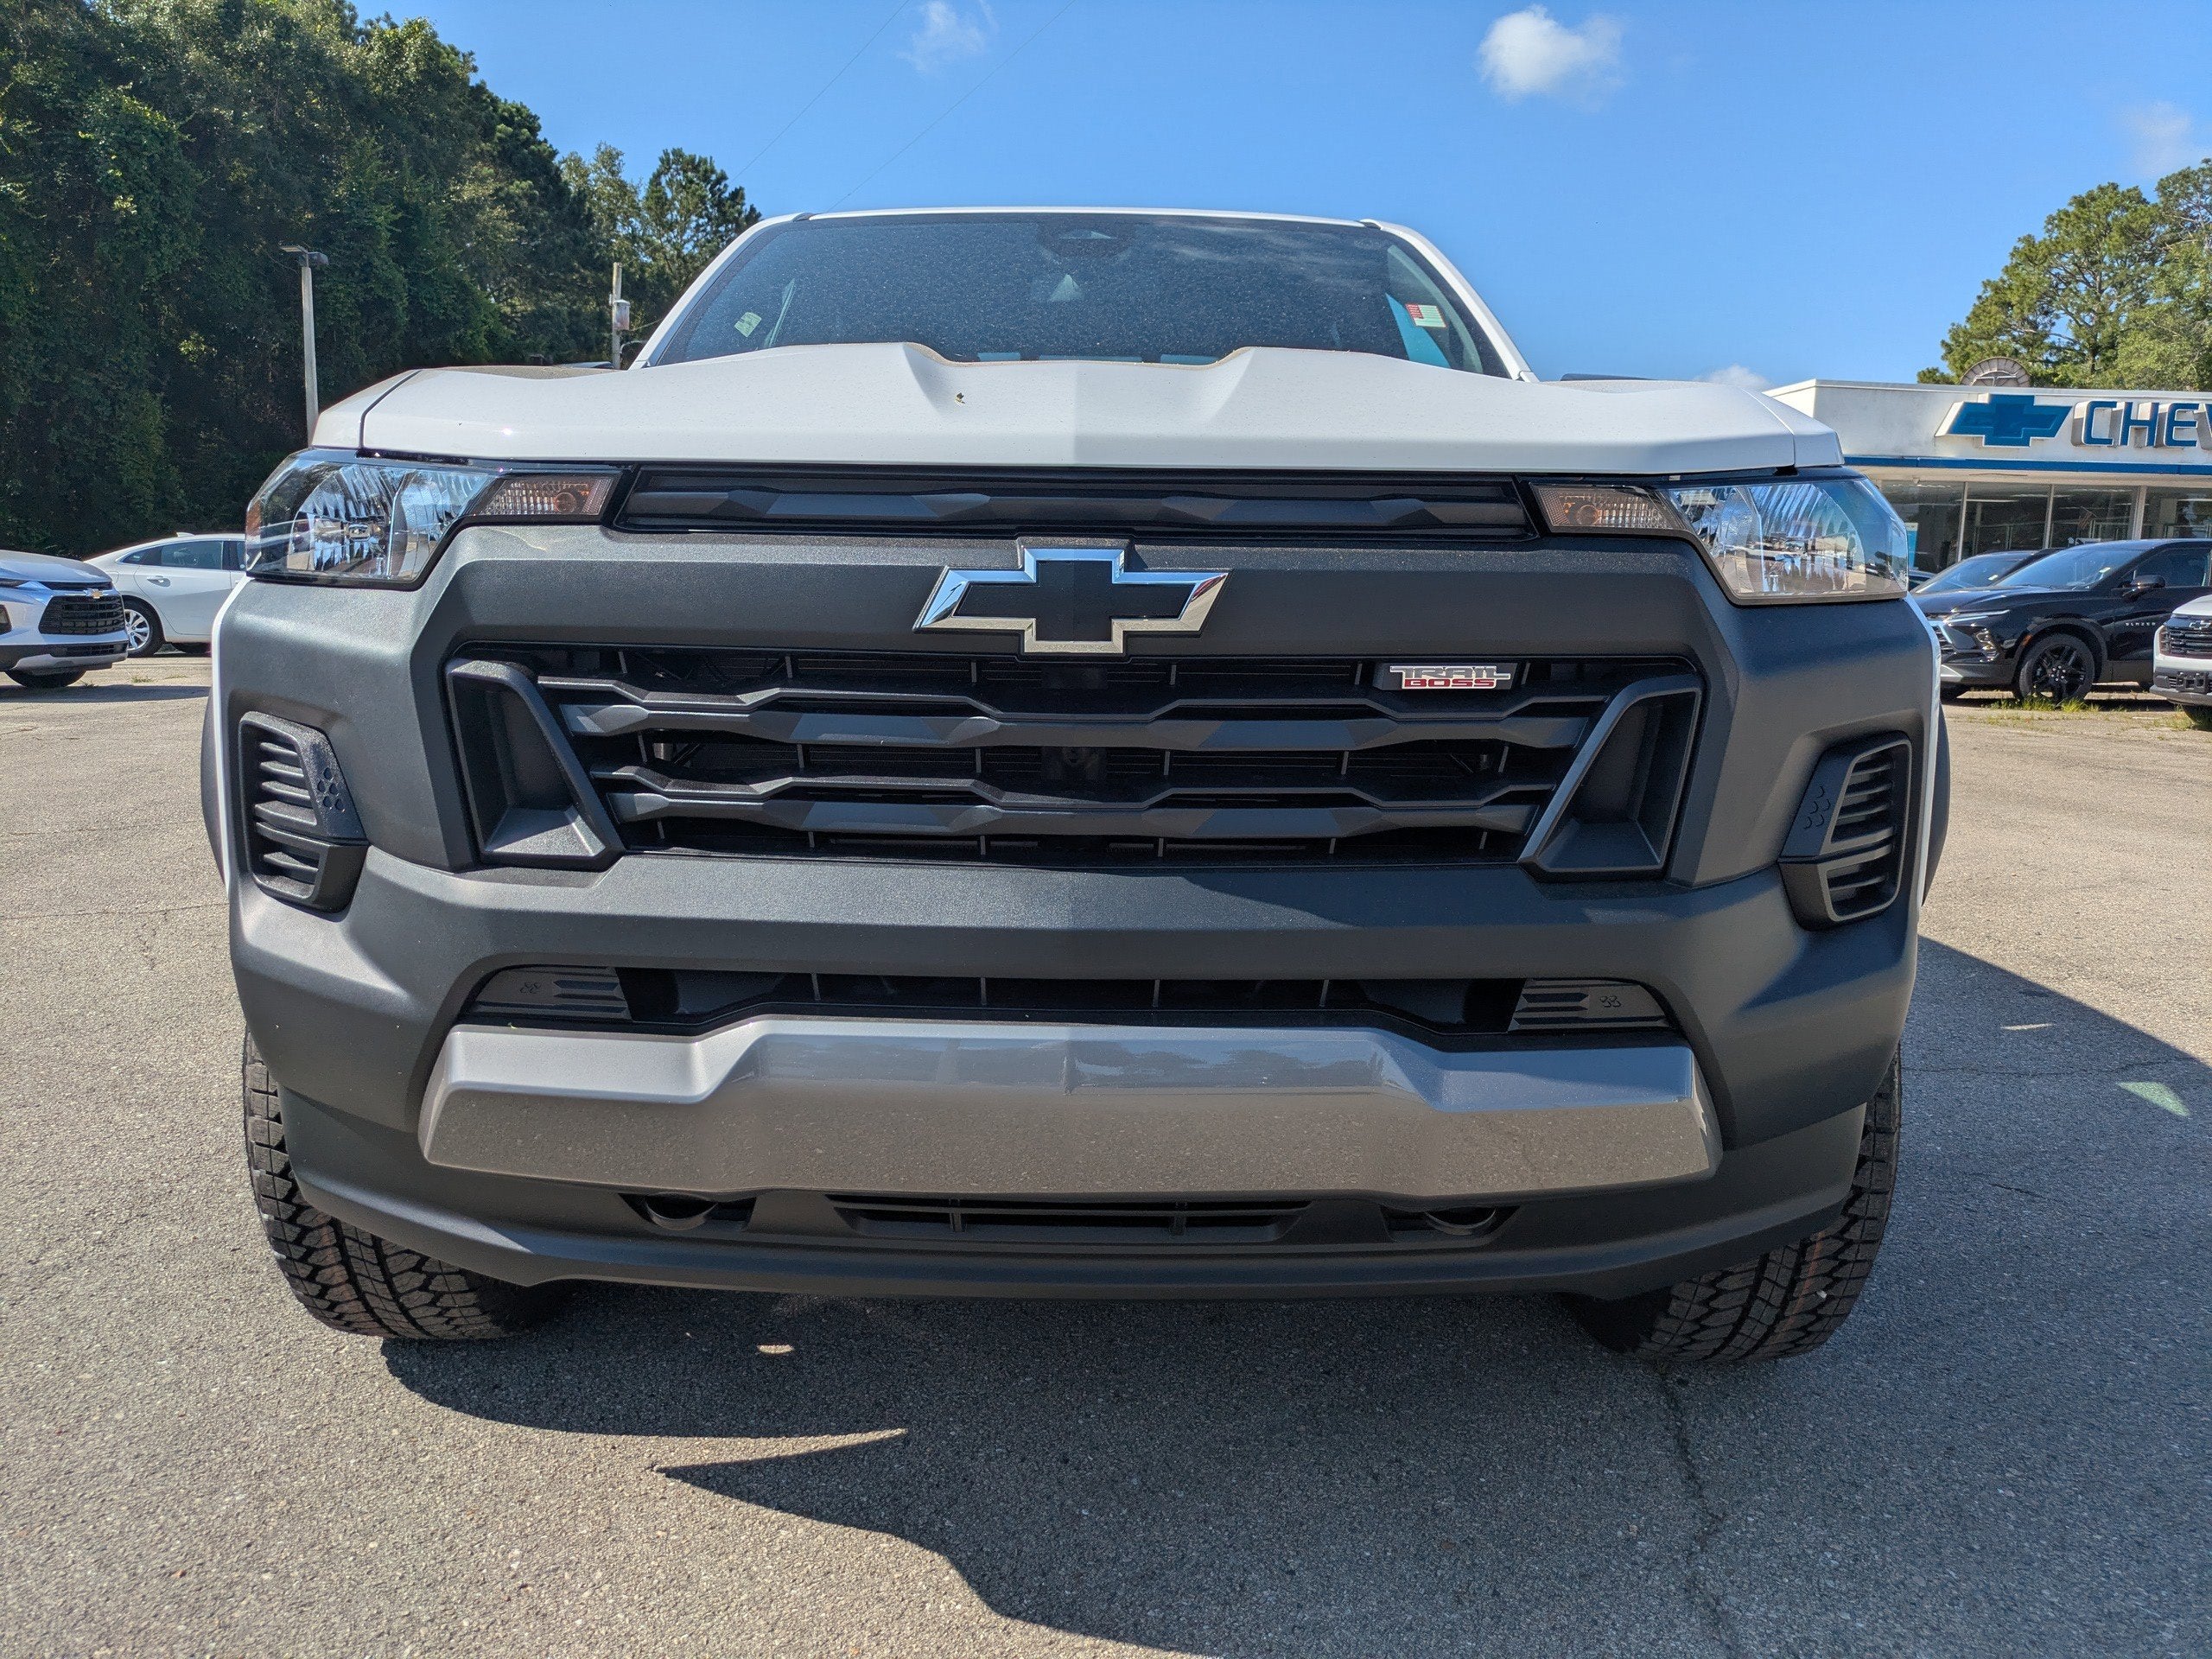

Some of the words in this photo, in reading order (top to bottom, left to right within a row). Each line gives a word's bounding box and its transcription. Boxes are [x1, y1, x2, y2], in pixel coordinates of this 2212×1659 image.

[2081, 400, 2212, 448] CHE
[1389, 665, 1511, 680] TRAIL
[1402, 678, 1497, 690] BOSS
